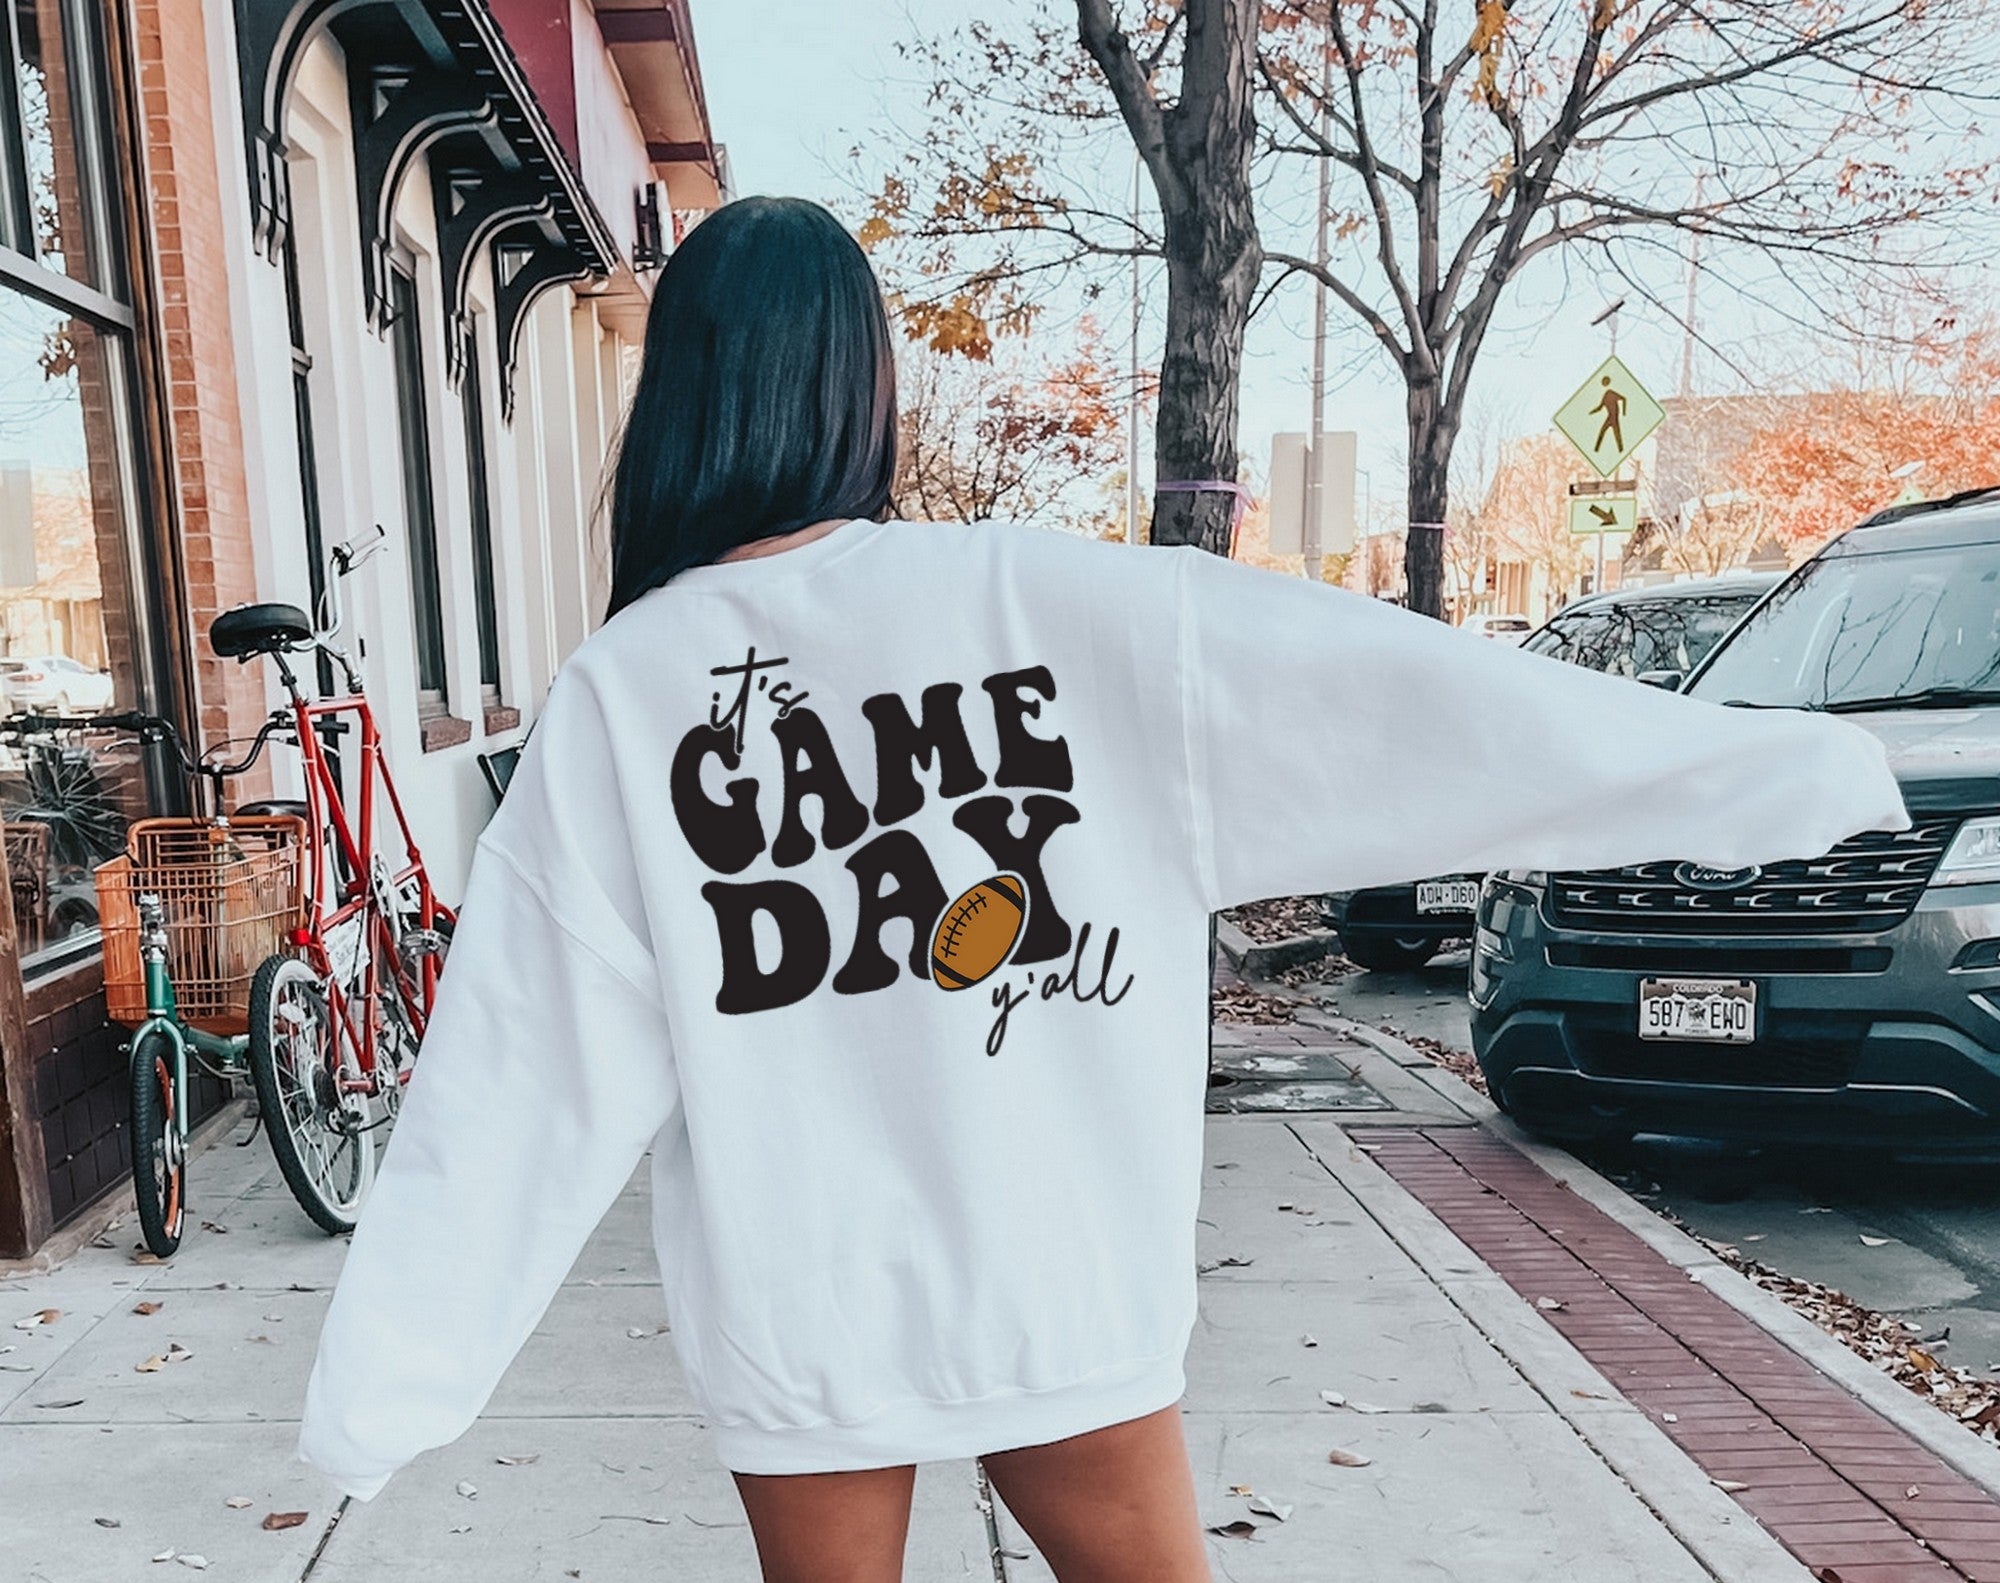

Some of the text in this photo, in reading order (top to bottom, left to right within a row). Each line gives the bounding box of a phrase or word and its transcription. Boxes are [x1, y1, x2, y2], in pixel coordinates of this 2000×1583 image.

[710, 646, 810, 754] it's
[669, 664, 1074, 875] GAME
[700, 794, 1081, 1016] DAY
[986, 922, 1134, 1057] y'all
[1649, 1000, 1686, 1027] 587
